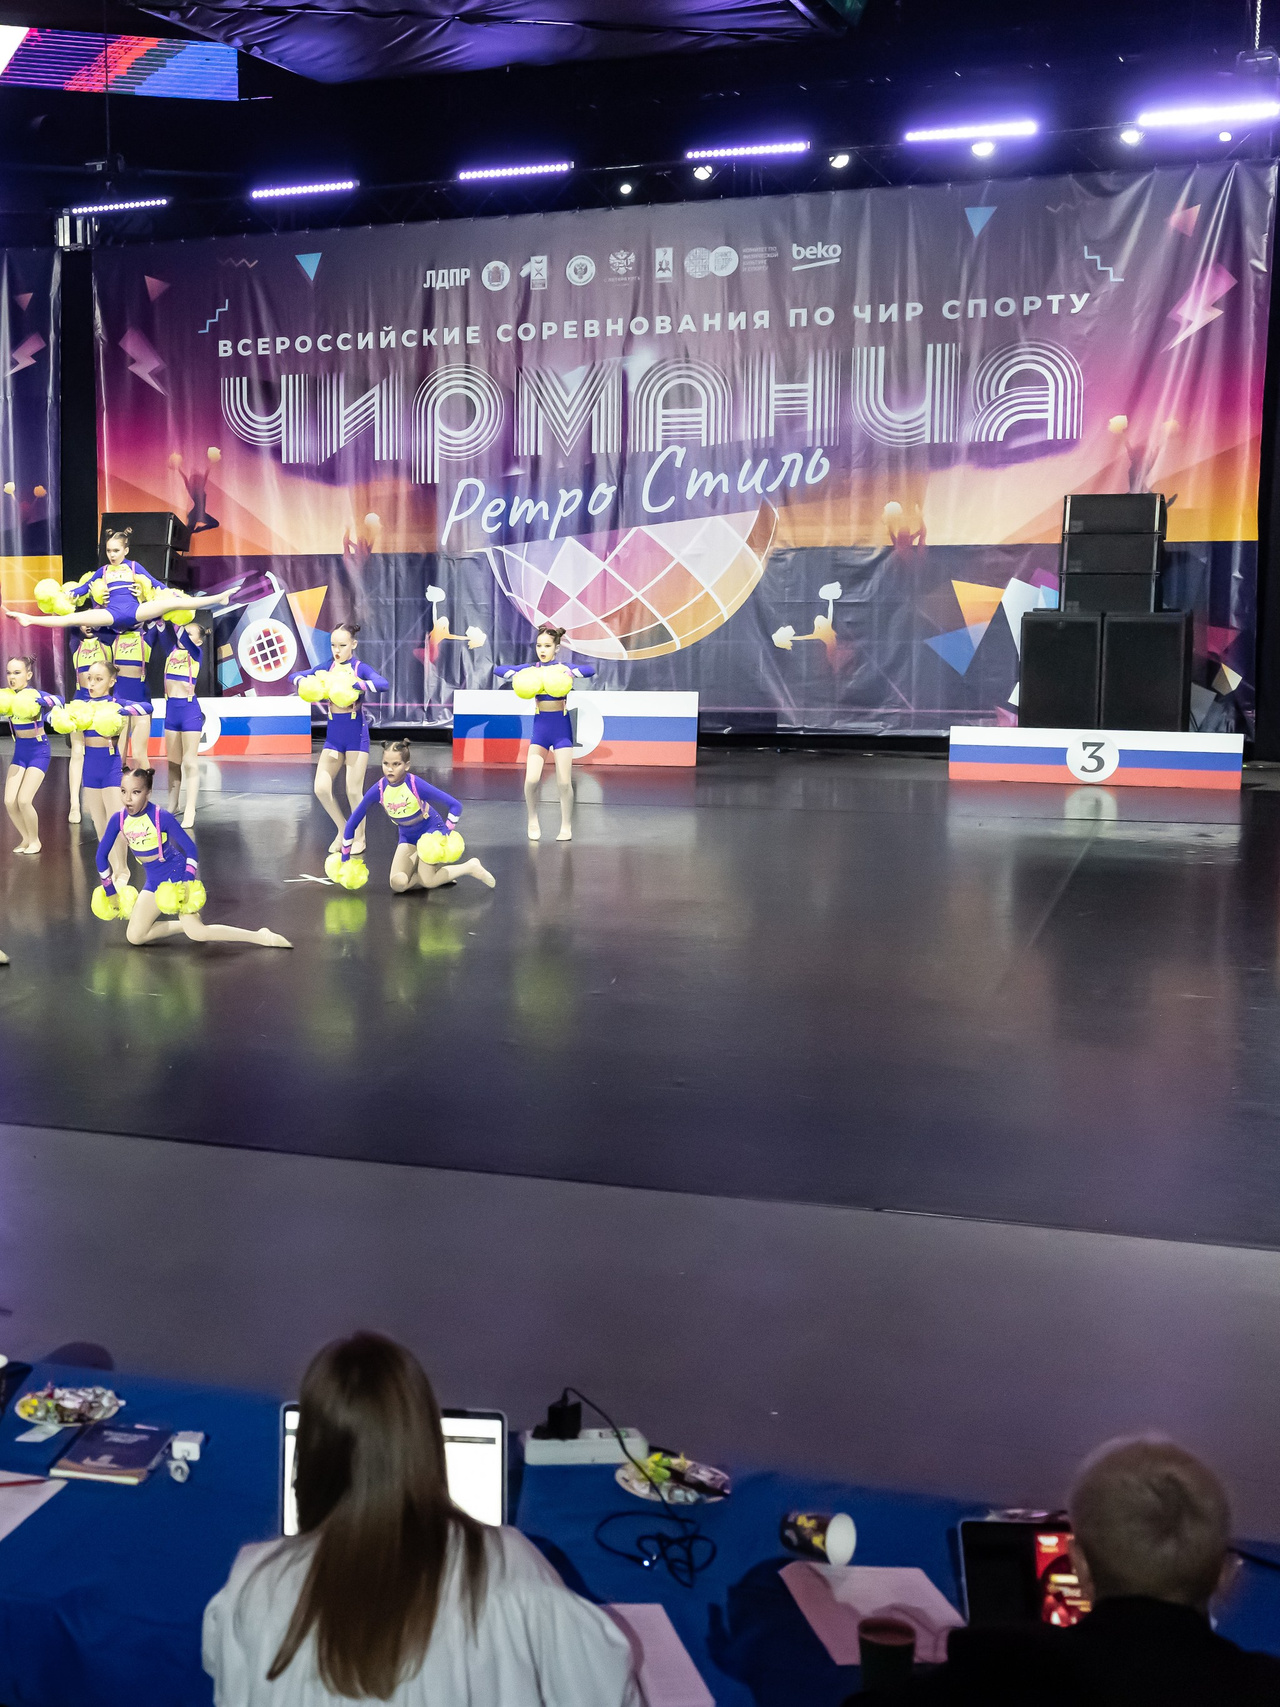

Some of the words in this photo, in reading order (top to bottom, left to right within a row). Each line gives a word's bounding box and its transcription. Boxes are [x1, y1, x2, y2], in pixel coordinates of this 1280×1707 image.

[791, 241, 842, 260] beko
[423, 267, 471, 290] ЛДПР
[218, 326, 481, 358] ВСЕРОССИЙСКИЕ
[496, 310, 770, 342] СОРЕВНОВАНИЯ
[789, 306, 835, 328] ПО
[853, 302, 924, 323] ЧИР
[942, 293, 1091, 320] СПОРТУ
[441, 477, 617, 546] Ретро
[641, 445, 831, 513] Стиль
[1080, 741, 1106, 773] 3
